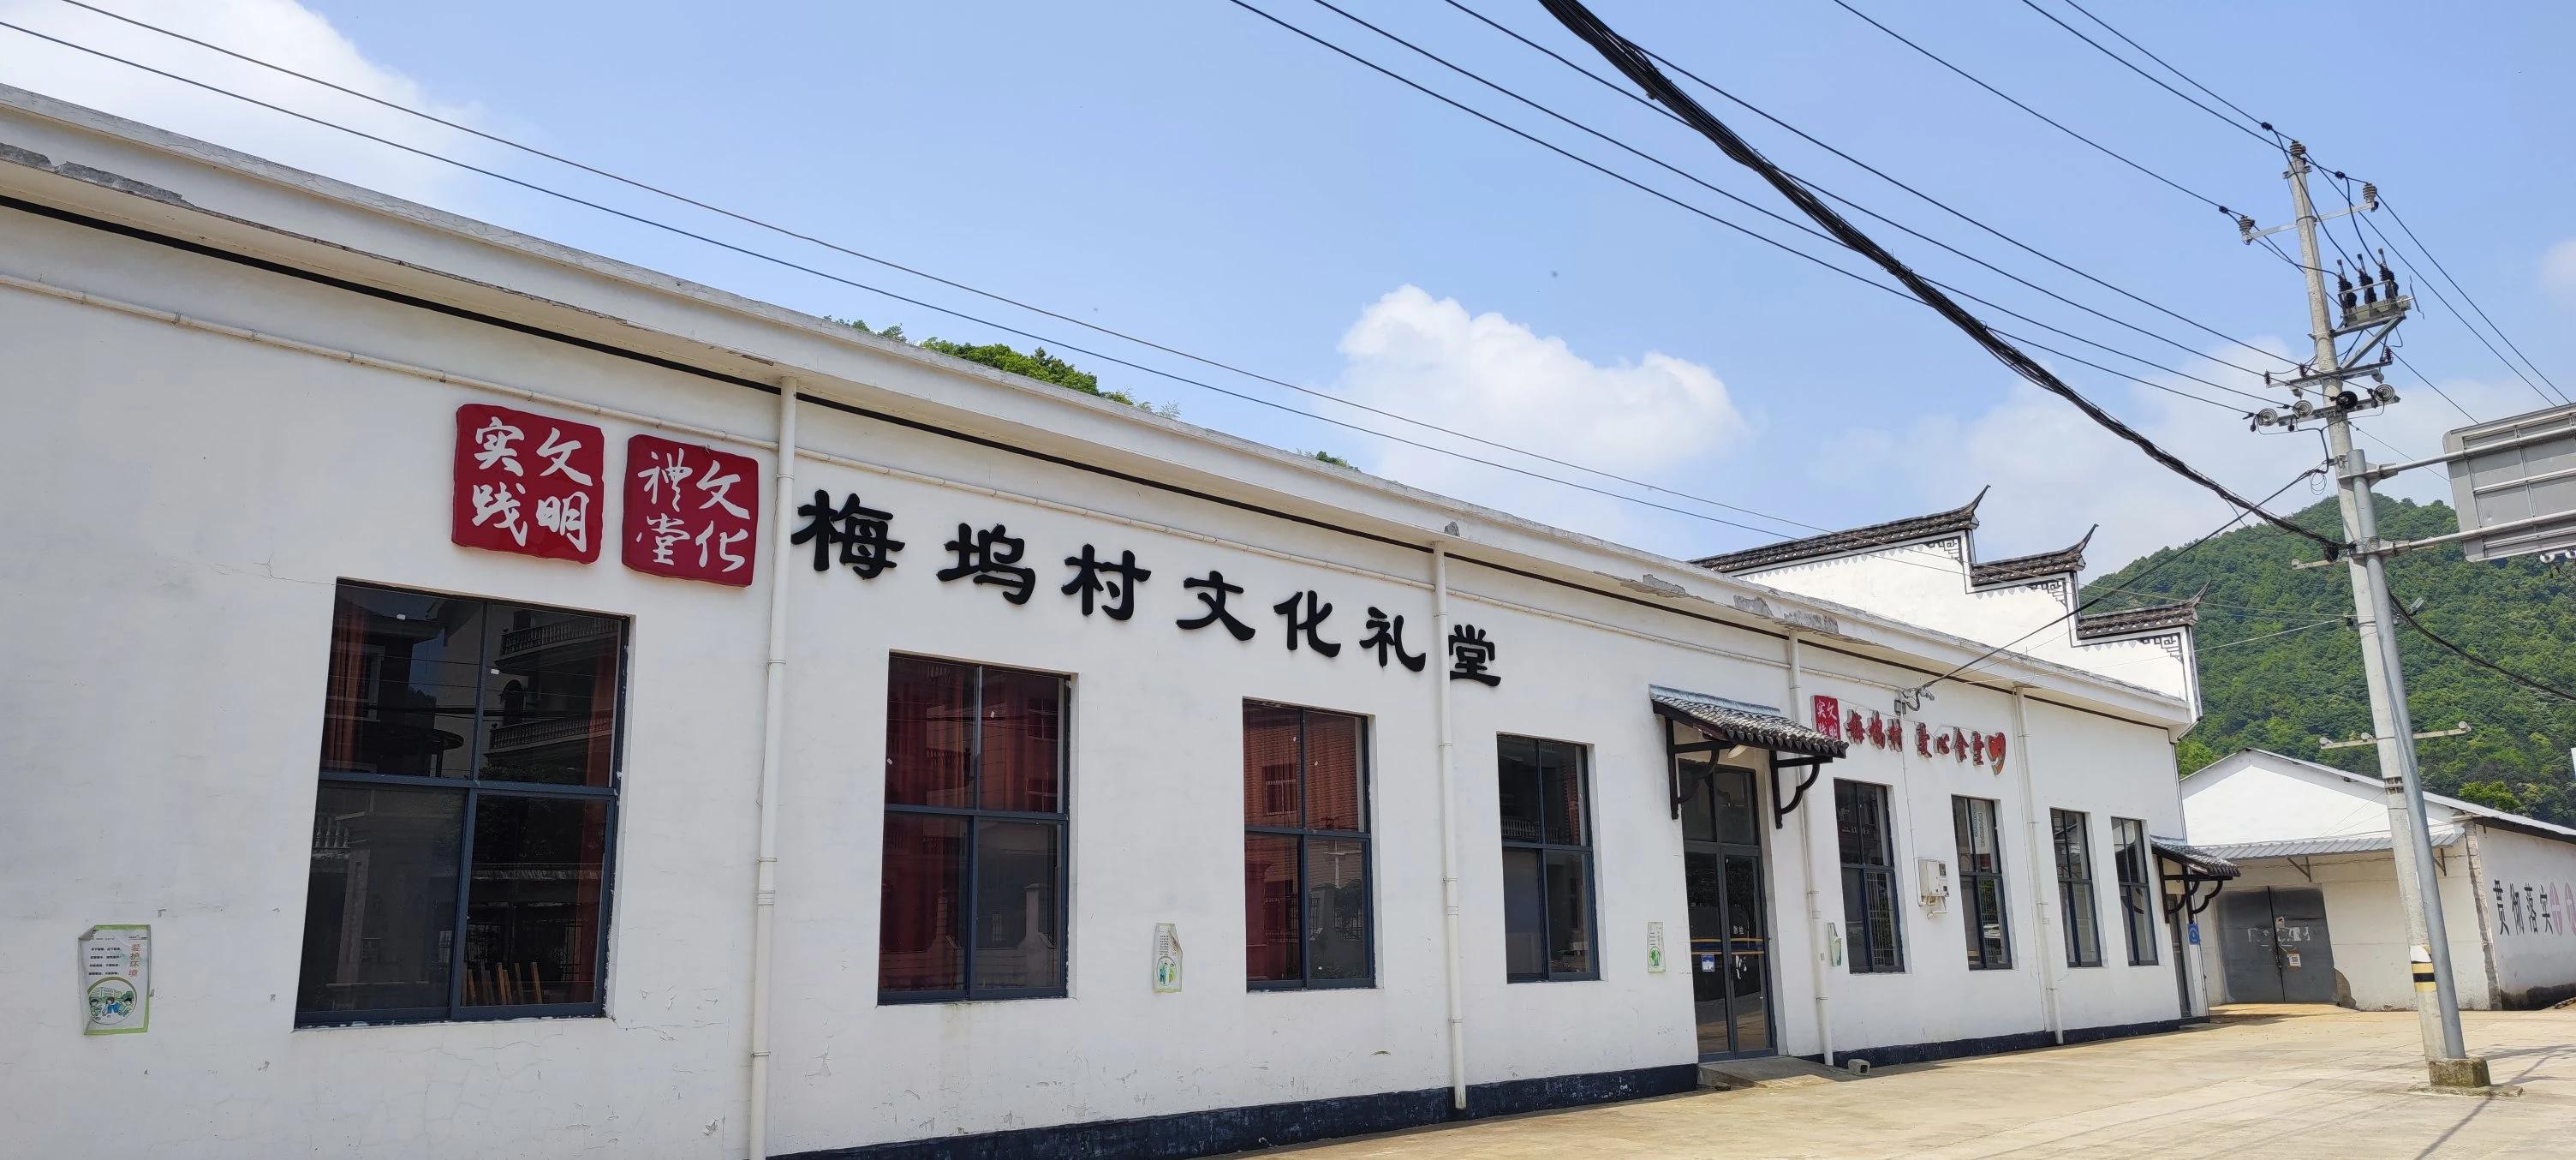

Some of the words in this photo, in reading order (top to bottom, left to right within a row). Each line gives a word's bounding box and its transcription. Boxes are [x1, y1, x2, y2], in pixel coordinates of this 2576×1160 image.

[472, 416, 528, 547] 实践
[536, 427, 593, 553] 文明
[695, 459, 750, 572] 文化
[790, 487, 1502, 687] 梅坞村文化礼堂
